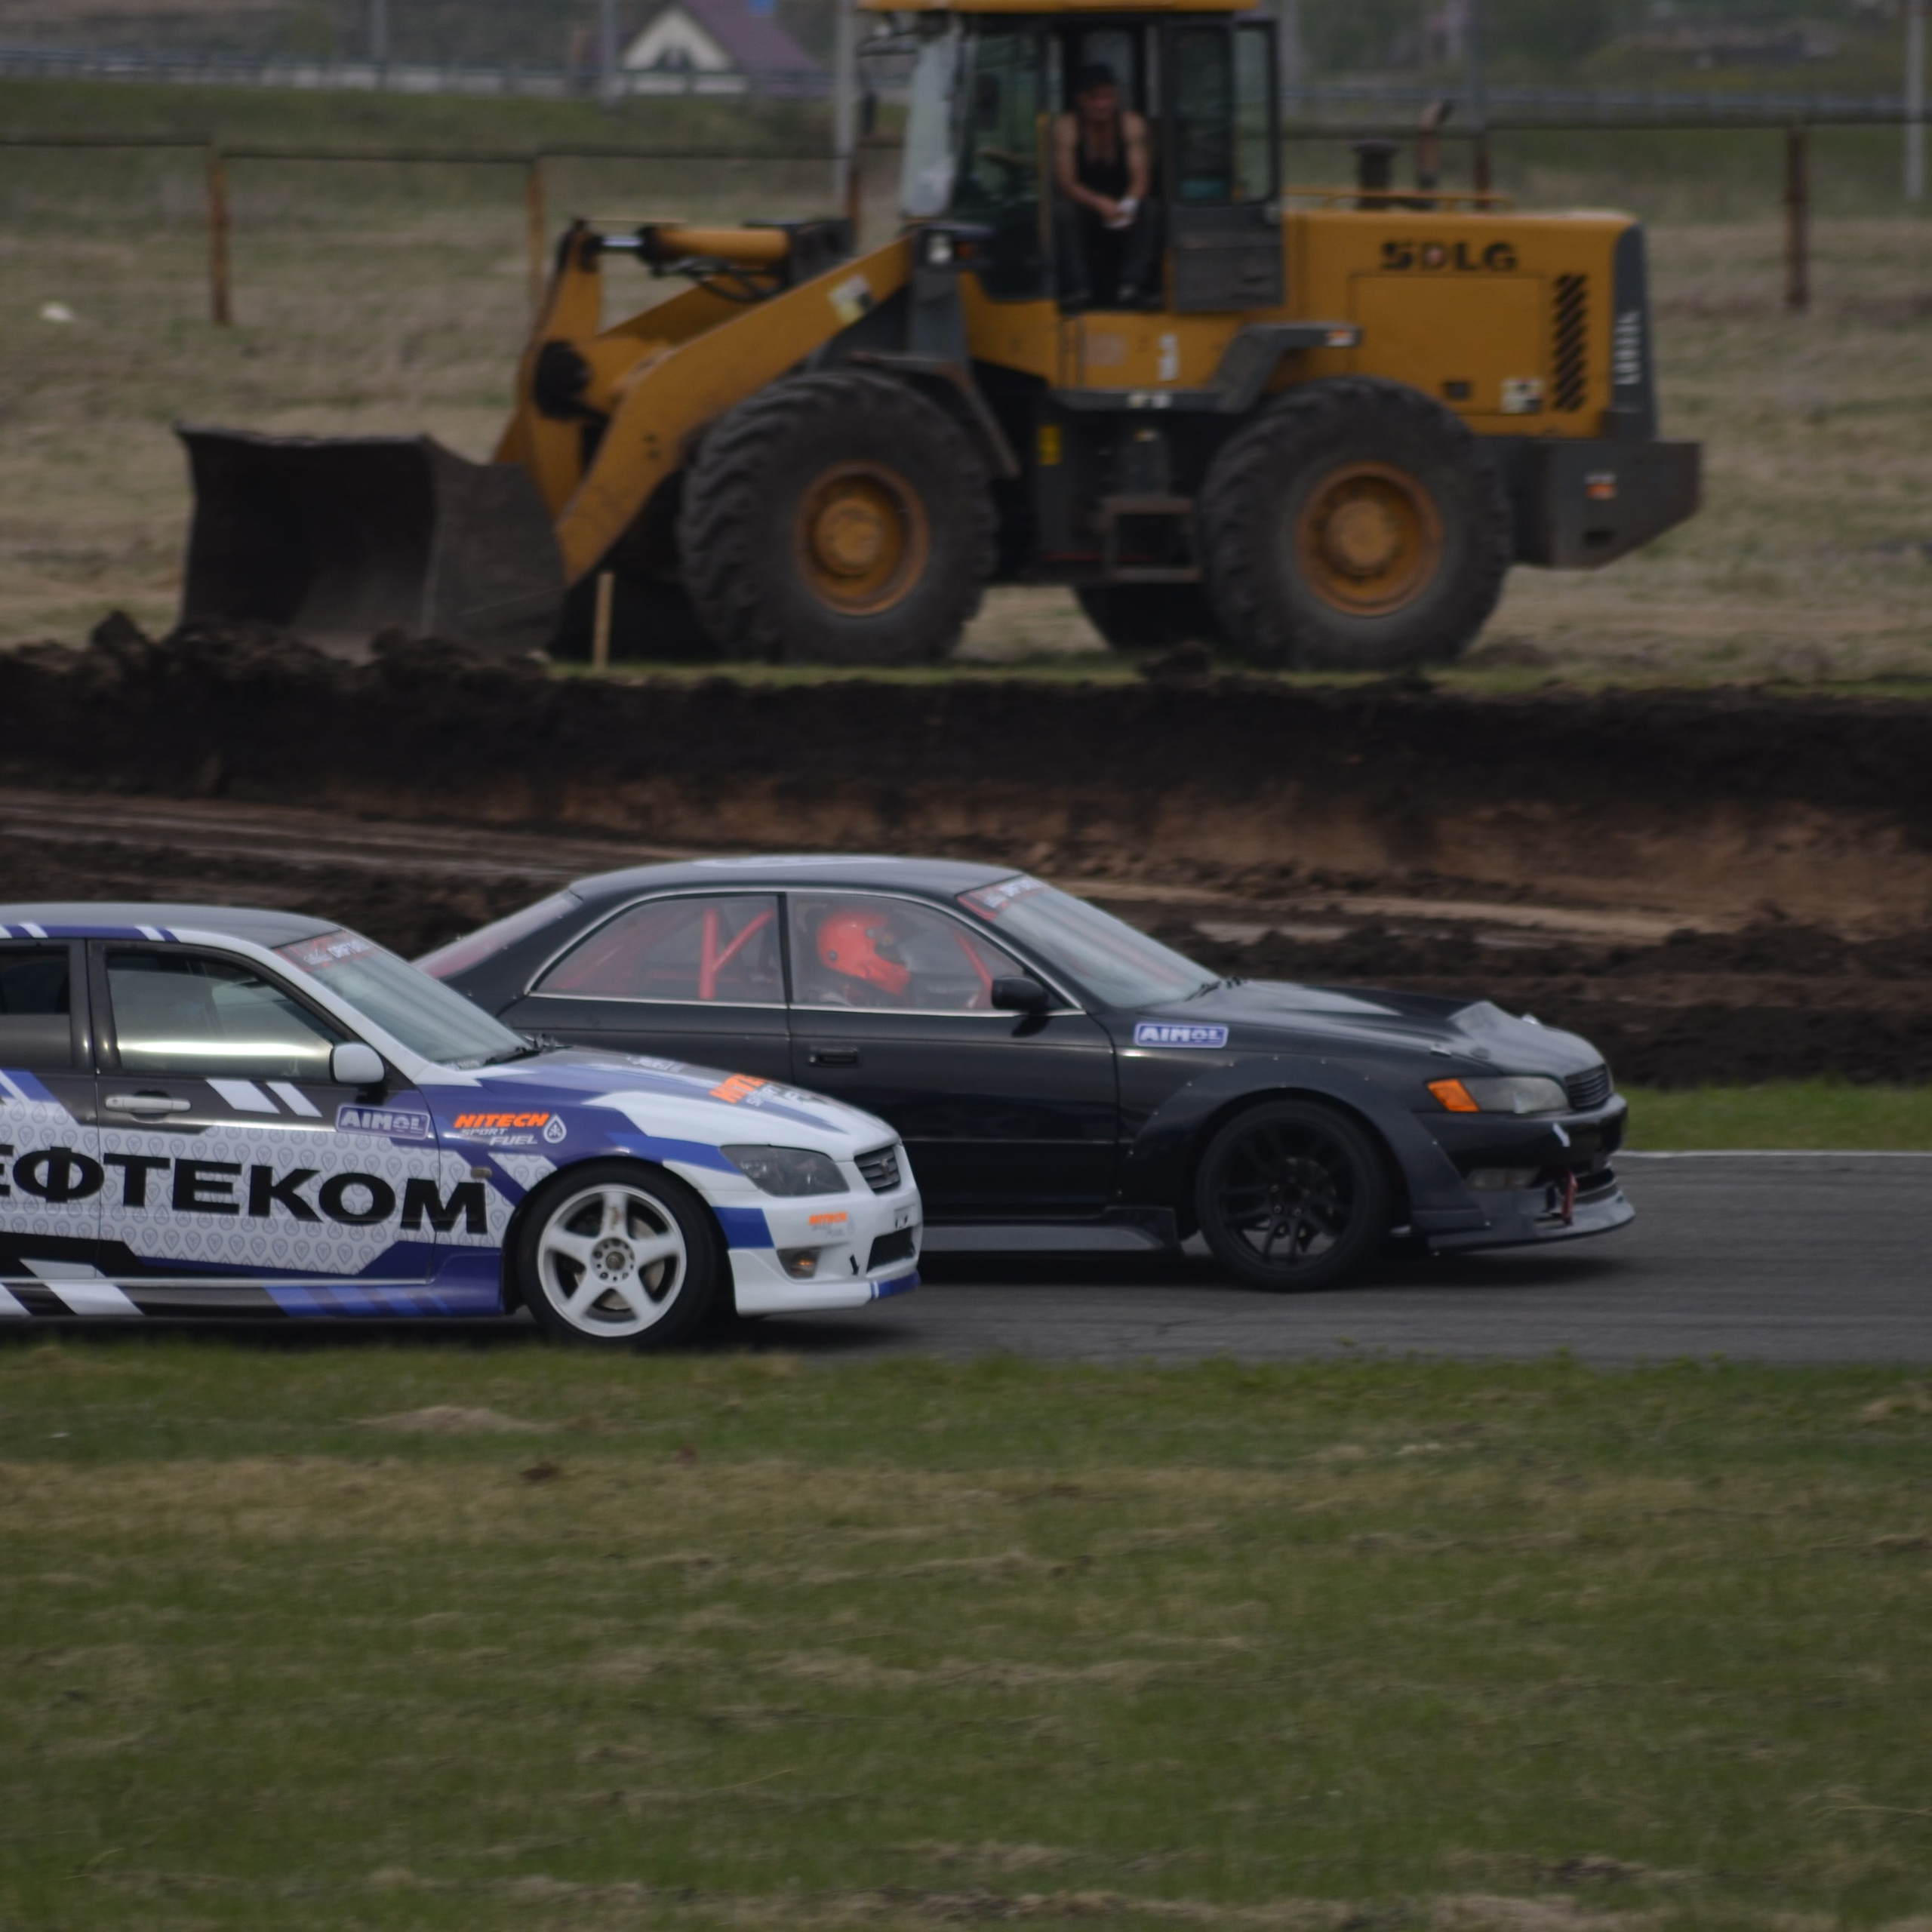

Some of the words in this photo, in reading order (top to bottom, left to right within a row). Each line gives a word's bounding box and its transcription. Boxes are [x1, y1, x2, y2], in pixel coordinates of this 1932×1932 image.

[1381, 242, 1518, 271] SDLG
[1140, 1026, 1222, 1043] AIMOL
[340, 1109, 424, 1134] AIMOL
[454, 1112, 550, 1129] HITECH
[461, 1128, 508, 1137] SPORT
[489, 1135, 538, 1146] FUEL
[0, 1143, 488, 1235] ФТЕКОМ
